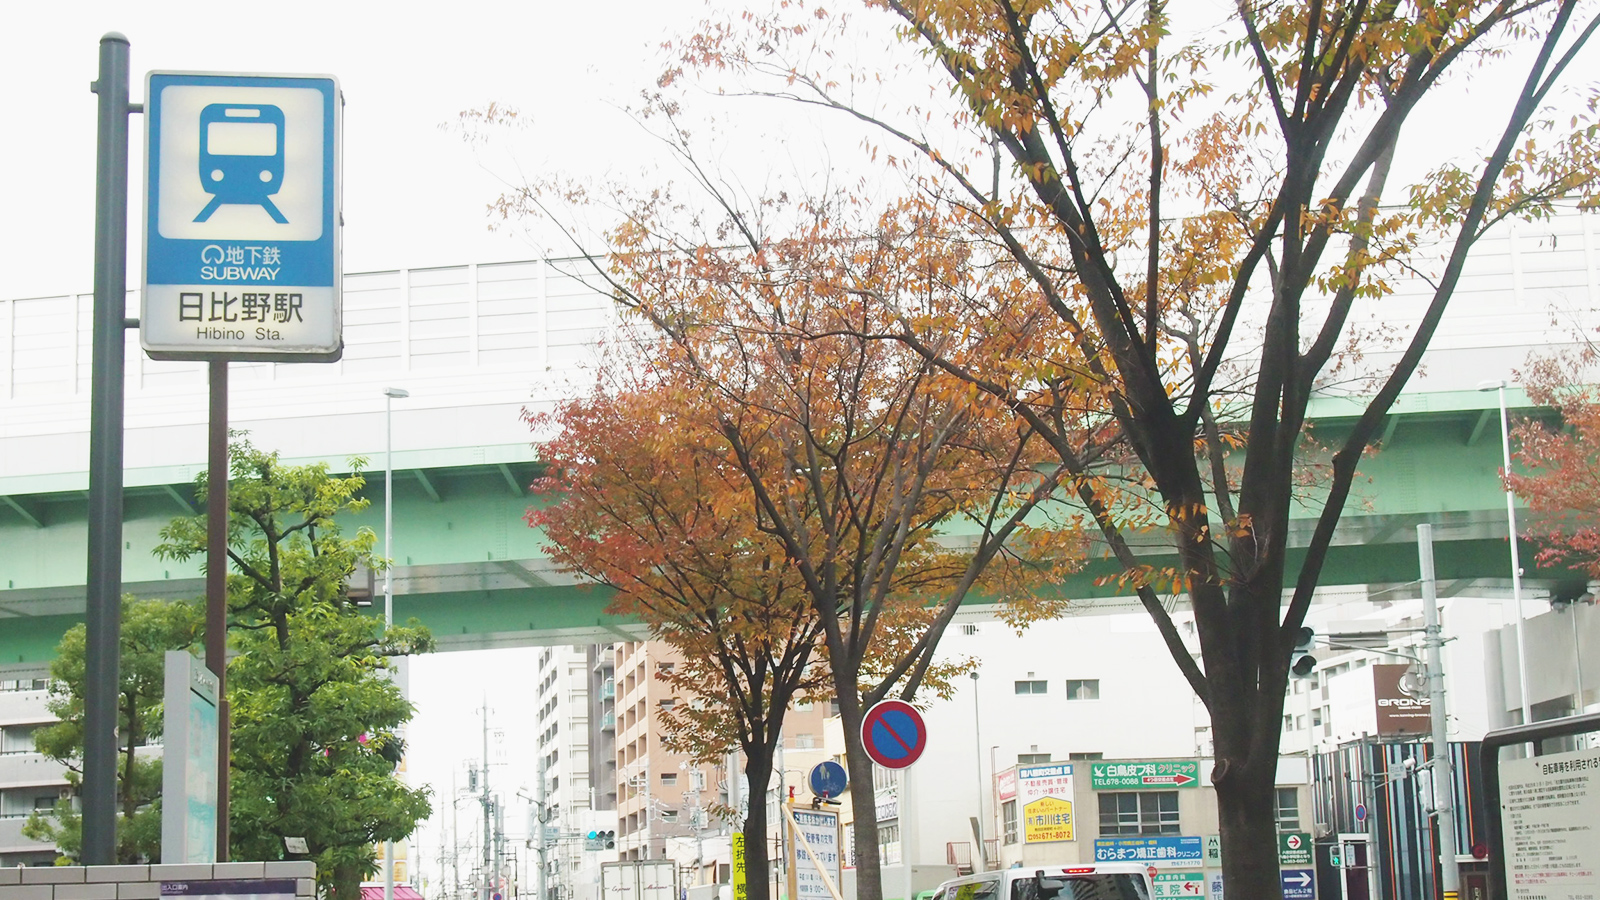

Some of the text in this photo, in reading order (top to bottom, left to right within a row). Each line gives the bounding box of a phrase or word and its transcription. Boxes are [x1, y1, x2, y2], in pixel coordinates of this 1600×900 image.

[226, 245, 281, 265] 地下鉄
[200, 266, 281, 281] SUBWAY
[178, 291, 303, 323] 日比野駅
[196, 326, 285, 341] Hibino Sta.
[1377, 697, 1431, 707] BRONZ
[1542, 756, 1600, 775] 自転車等を利用される
